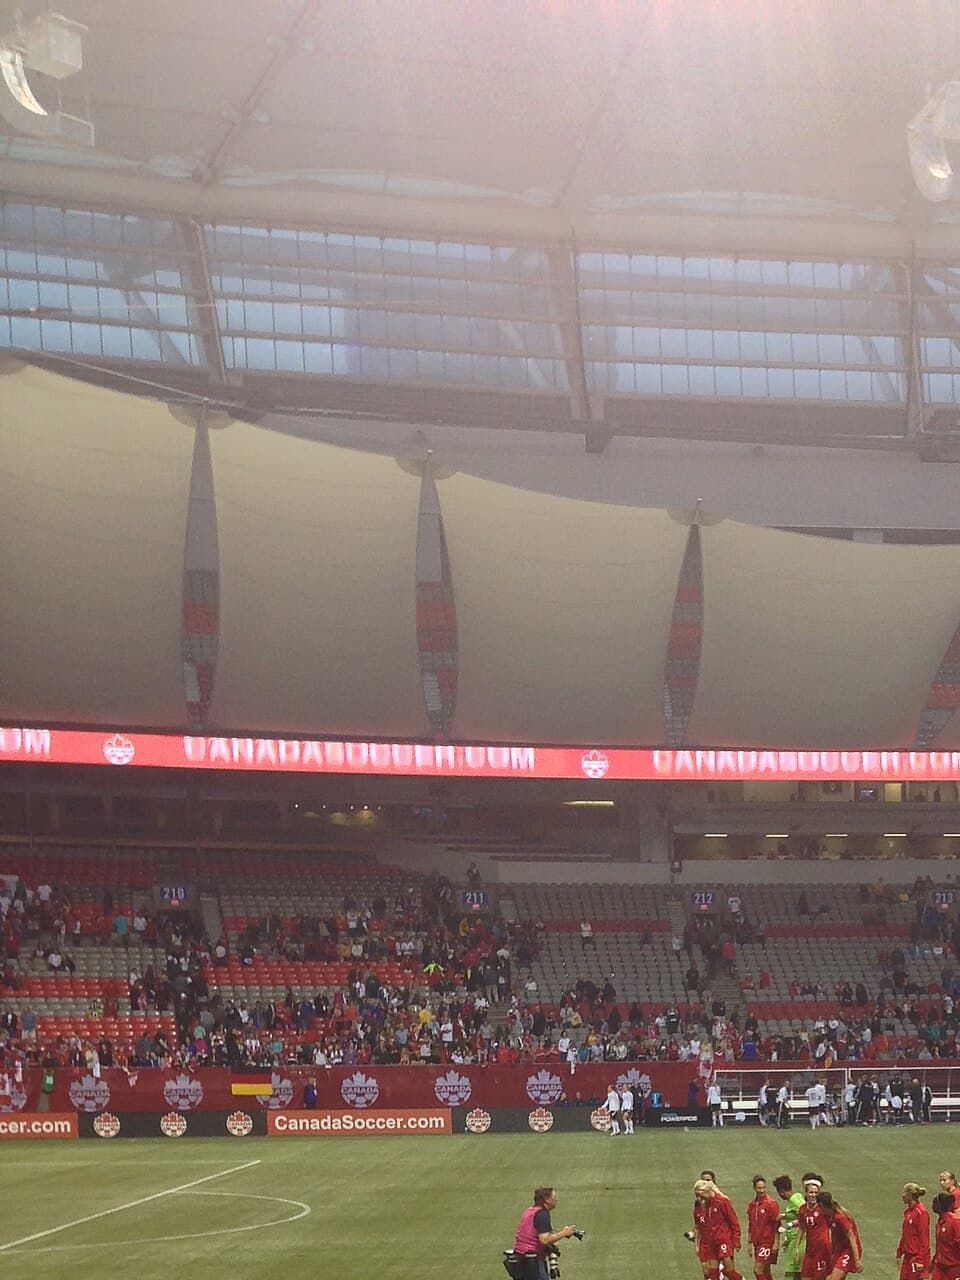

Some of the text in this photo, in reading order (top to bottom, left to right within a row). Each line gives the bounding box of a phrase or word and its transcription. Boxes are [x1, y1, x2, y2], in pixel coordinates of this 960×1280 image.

[465, 892, 484, 904] 211
[694, 893, 713, 904] 212
[935, 892, 953, 903] 213
[340, 1086, 379, 1094] CANADA
[434, 1085, 472, 1093] CANADA
[526, 1084, 563, 1092] CANADA
[274, 1115, 445, 1131] CanadaSoccer.com
[806, 1216, 815, 1227] 13
[758, 1247, 771, 1257] 20
[842, 1254, 850, 1264] 2
